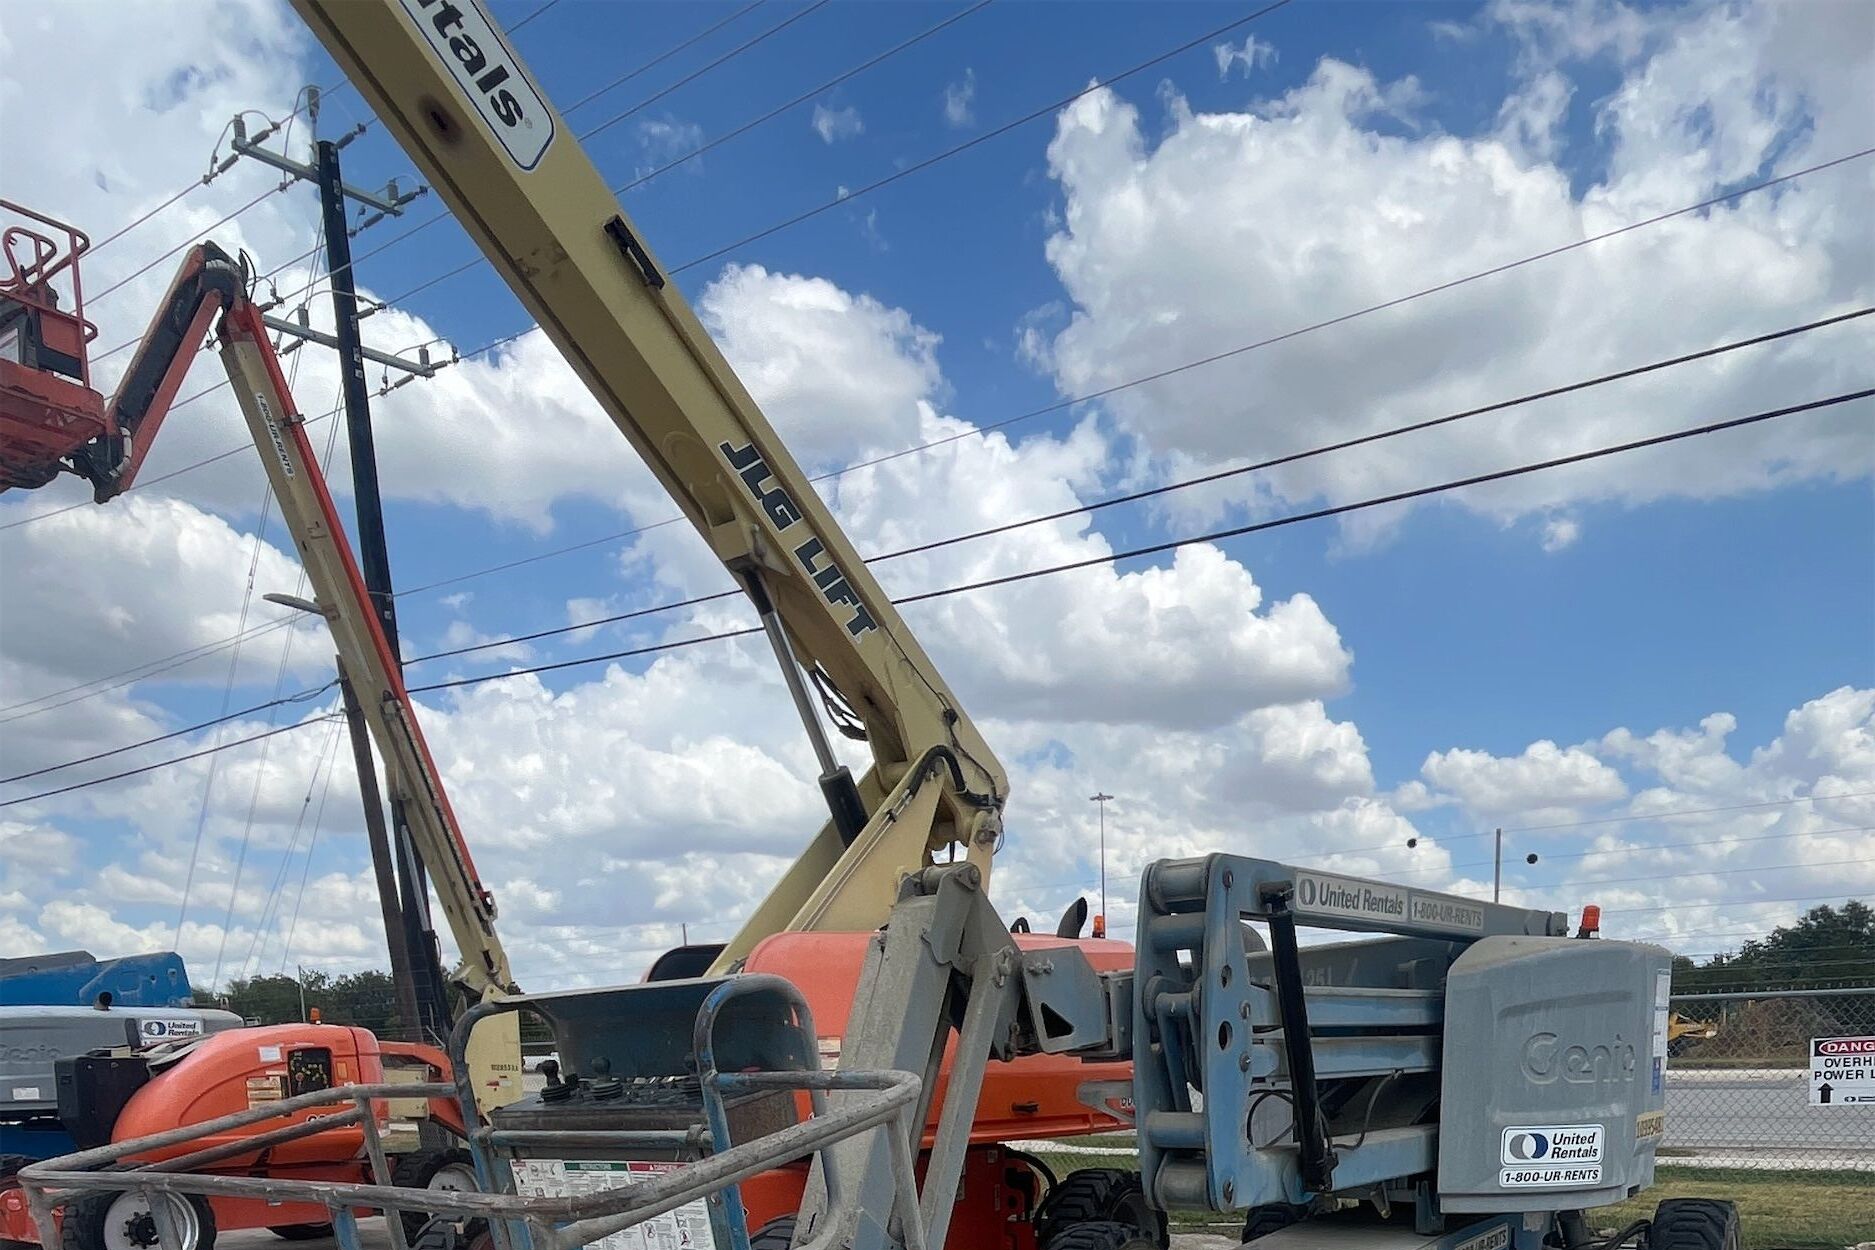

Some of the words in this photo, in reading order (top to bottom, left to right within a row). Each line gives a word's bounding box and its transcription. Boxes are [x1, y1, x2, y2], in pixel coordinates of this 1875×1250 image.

[719, 441, 803, 533] JLG
[793, 536, 879, 637] LIFT
[1319, 881, 1361, 911] United
[1362, 888, 1403, 916] Rentals
[1413, 901, 1482, 928] 1-800-UR-RENTS
[1520, 1032, 1637, 1085] Genie
[1824, 1056, 1875, 1068] OVERH
[1814, 1069, 1864, 1081] POWER
[1552, 1132, 1597, 1146] United
[1551, 1146, 1598, 1159] Rentals
[1504, 1169, 1600, 1183] 1-800-UR-RENTS
